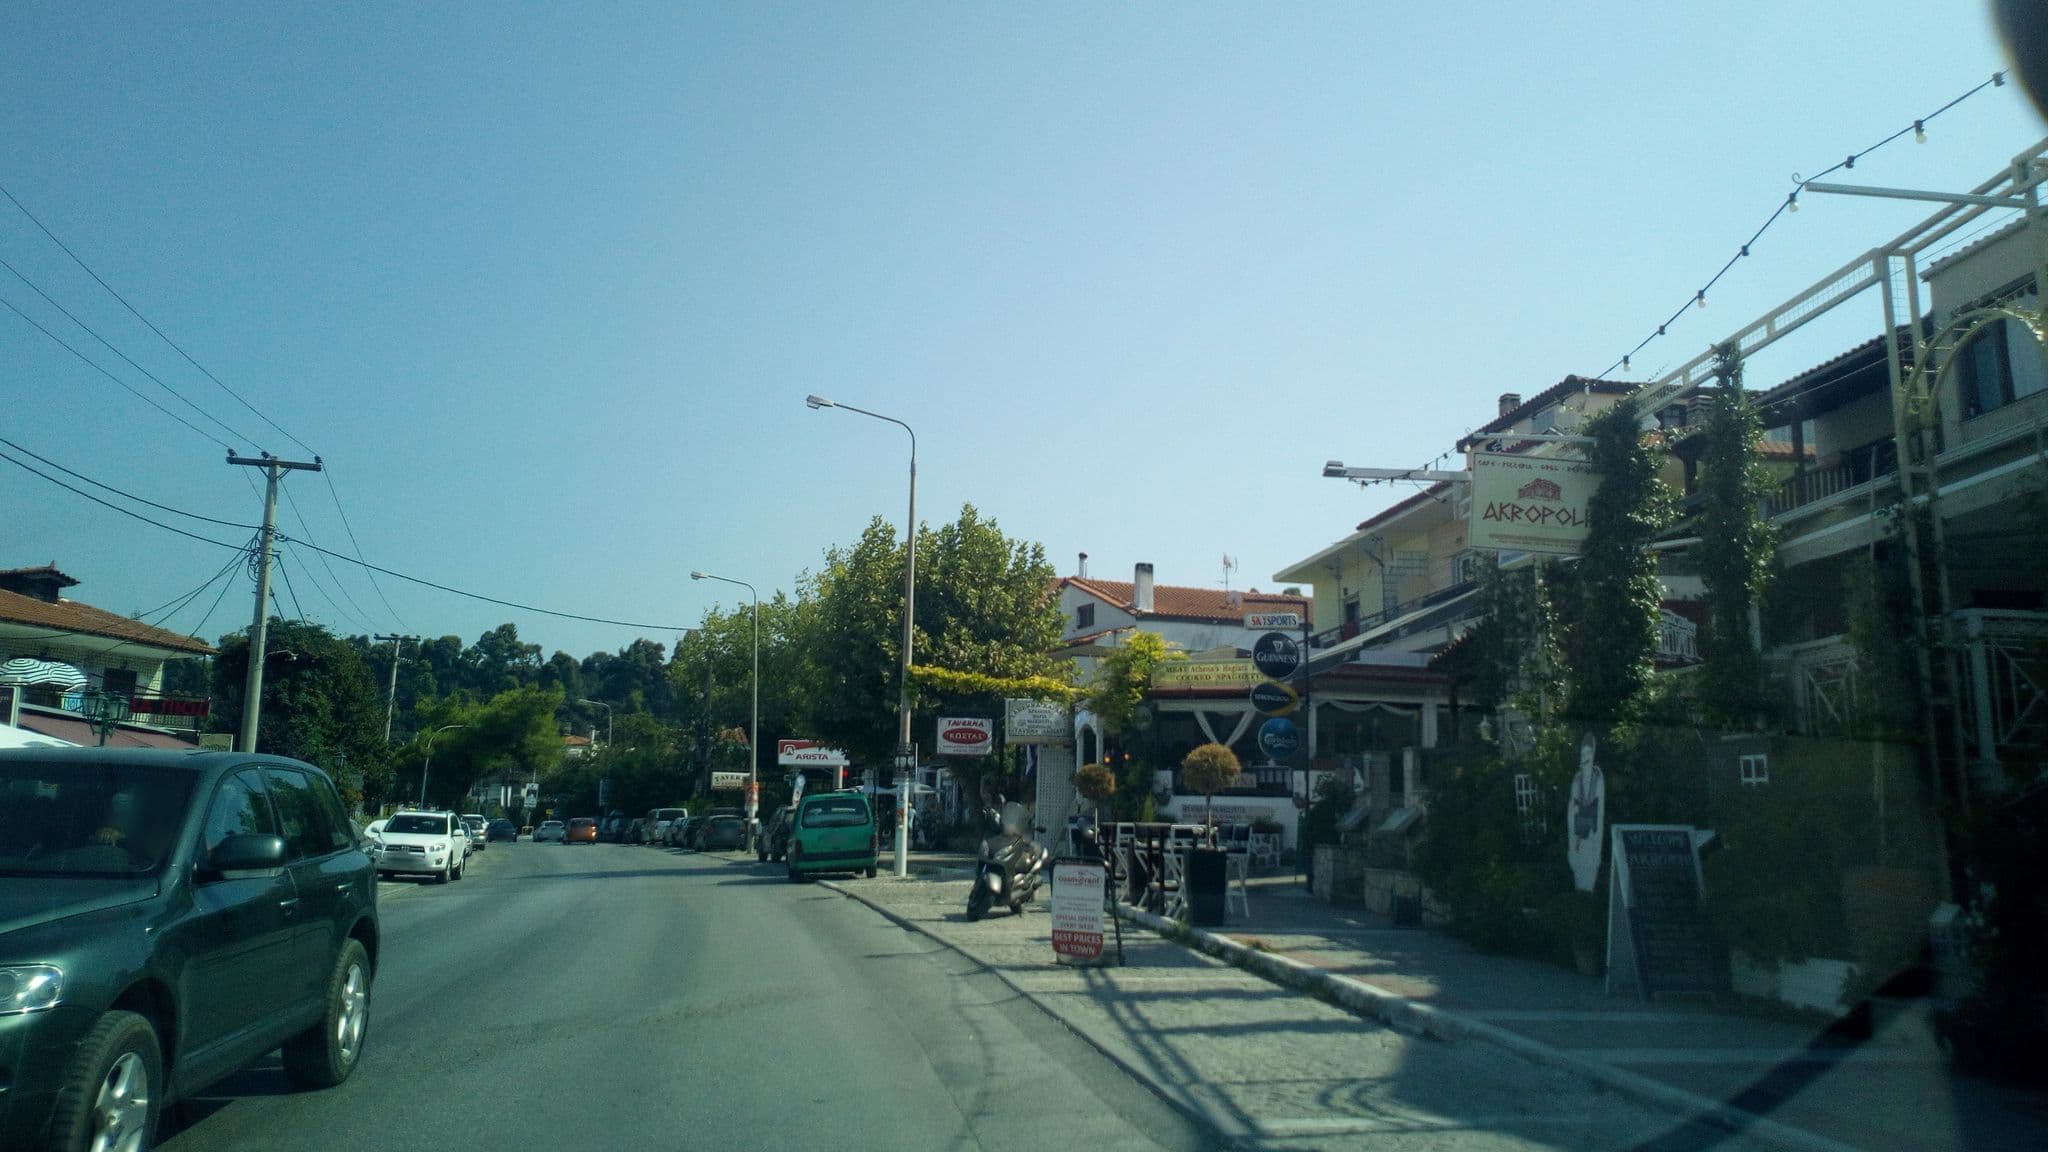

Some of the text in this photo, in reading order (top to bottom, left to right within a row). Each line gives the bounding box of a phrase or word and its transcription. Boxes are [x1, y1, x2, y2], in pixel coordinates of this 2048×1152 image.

[1482, 500, 1592, 528] AKROPOLI
[1256, 651, 1297, 665] GUINNESS
[947, 719, 984, 727] TAVERNA
[1054, 931, 1101, 945] BEST PRICES
